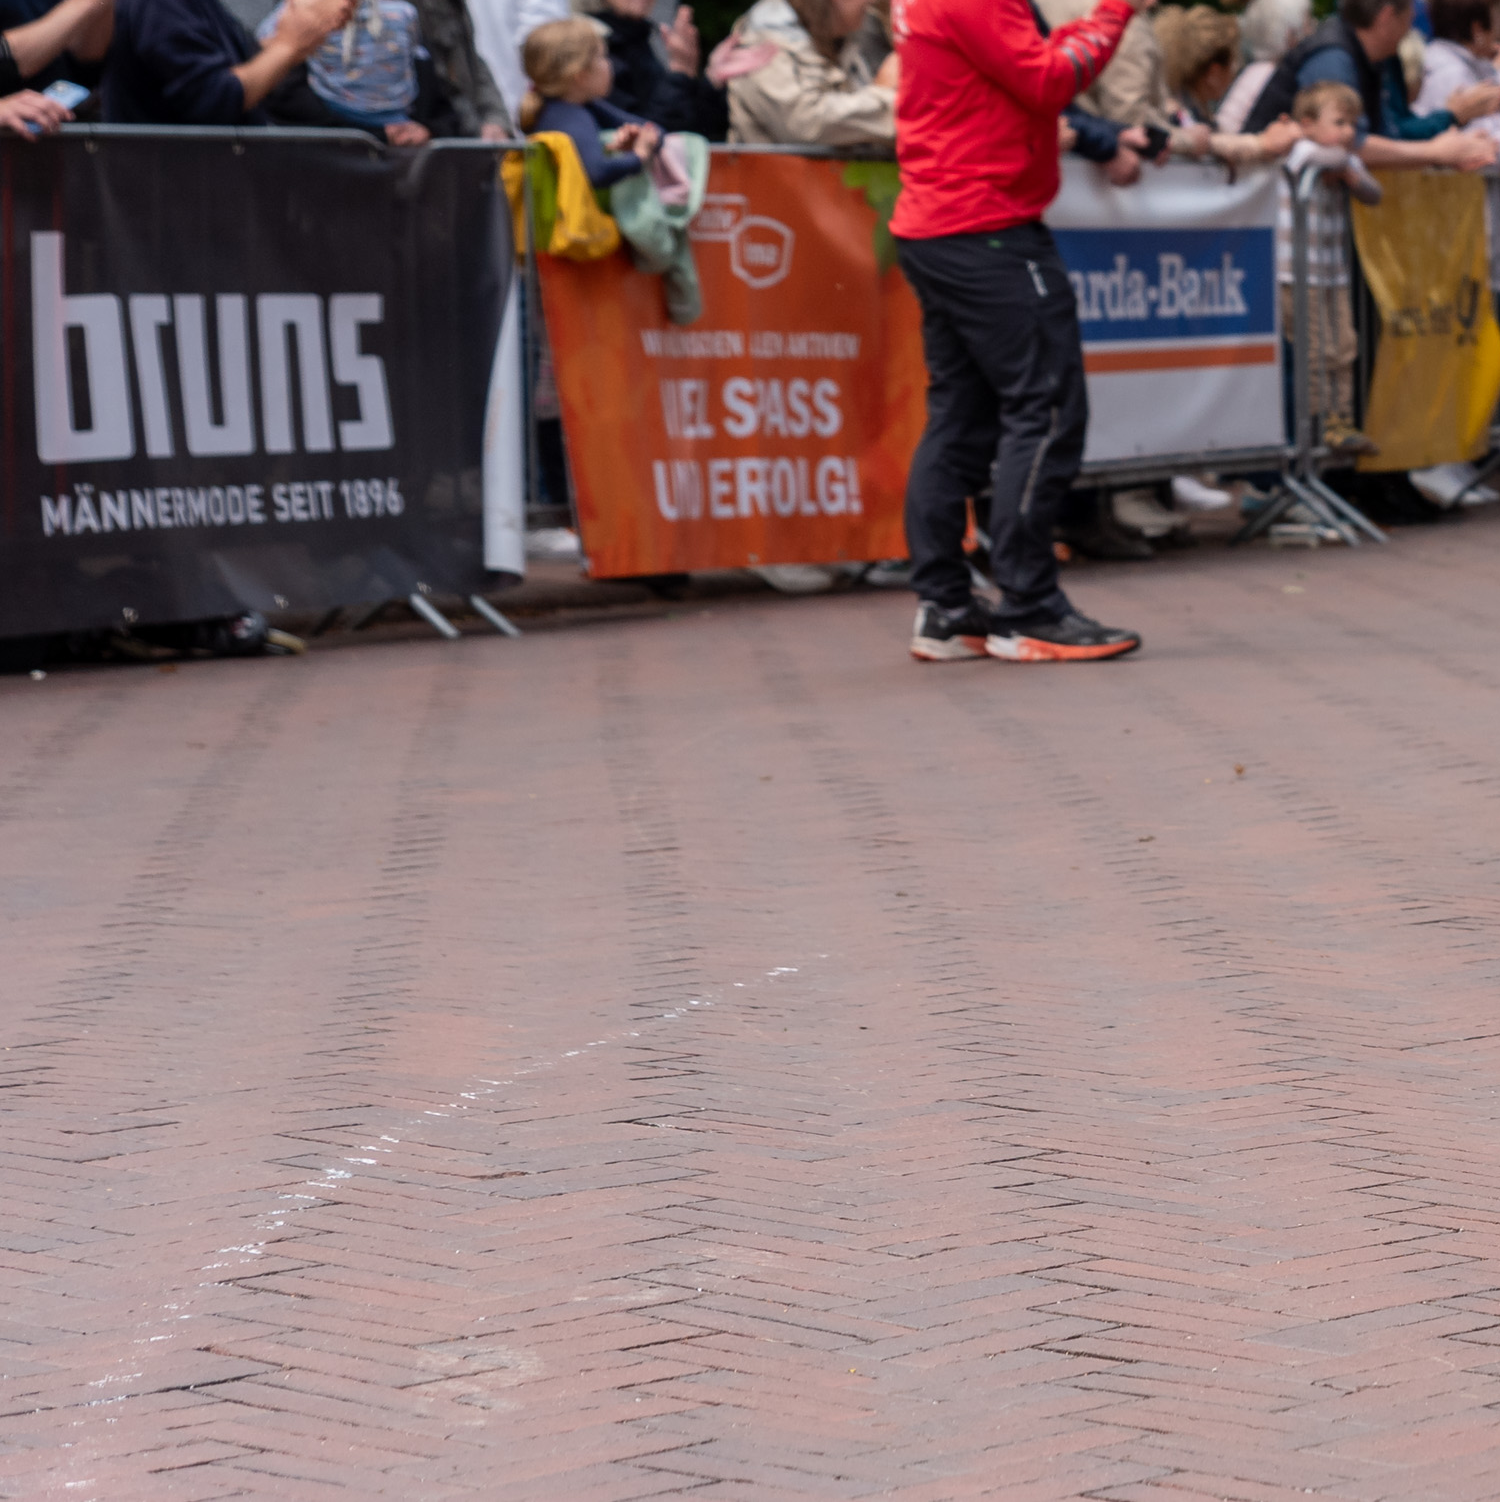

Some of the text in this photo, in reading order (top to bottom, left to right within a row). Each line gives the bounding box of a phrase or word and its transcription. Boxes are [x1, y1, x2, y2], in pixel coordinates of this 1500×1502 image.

[31, 231, 395, 465] bruns
[41, 478, 406, 537] MÄNNERMODE SEIT 1896
